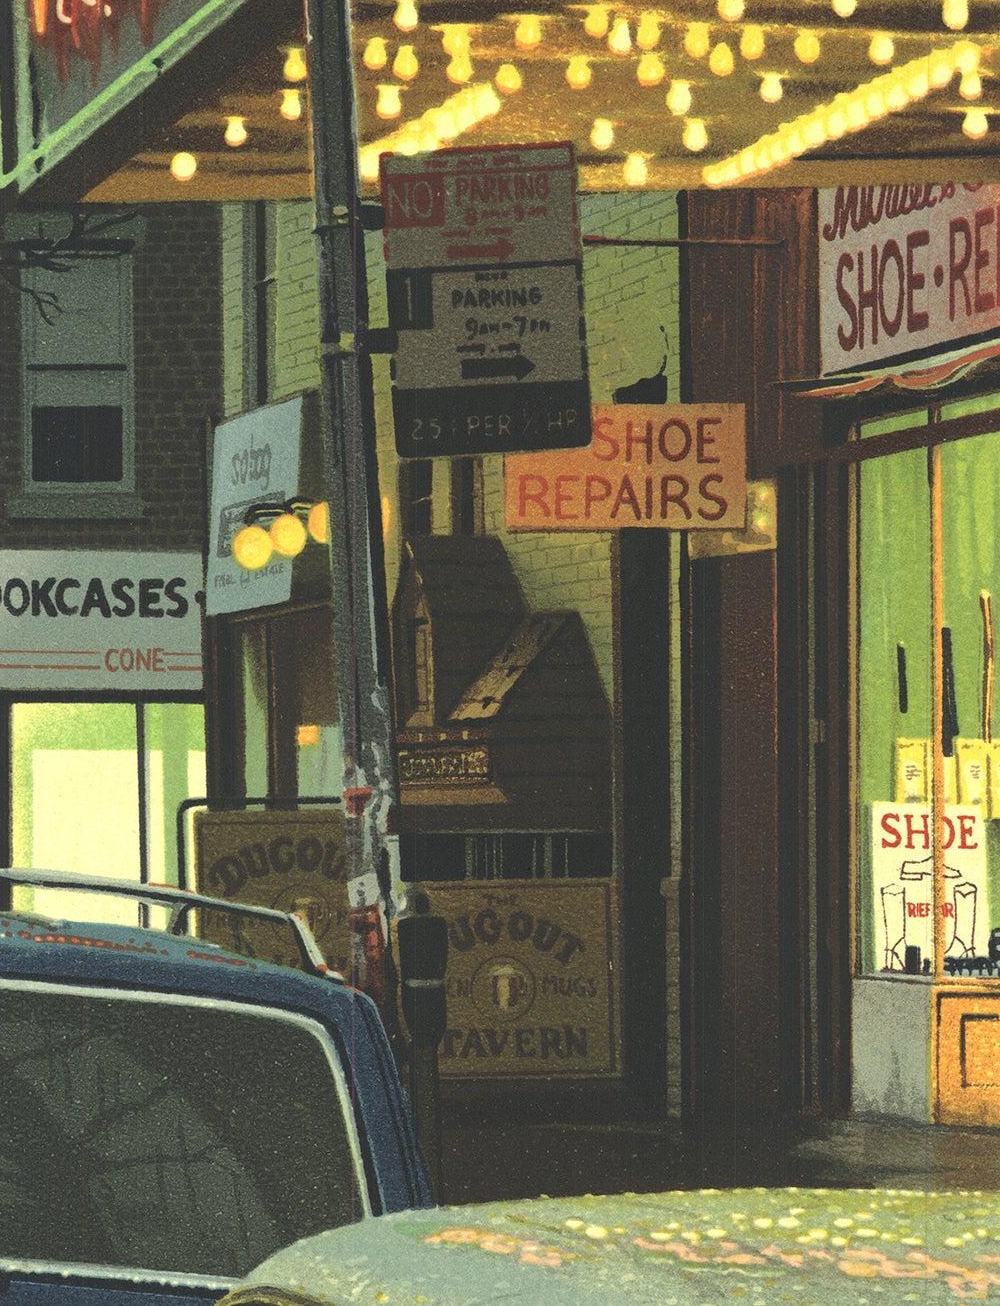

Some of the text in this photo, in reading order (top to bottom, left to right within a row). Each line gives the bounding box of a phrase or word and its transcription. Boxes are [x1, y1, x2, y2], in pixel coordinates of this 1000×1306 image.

[386, 181, 434, 220] NO
[451, 287, 544, 309] PARKING
[467, 415, 512, 437] PER
[592, 417, 722, 465] SHOE
[518, 474, 729, 522] REPAIRS
[105, 648, 166, 673] CONE
[440, 1027, 588, 1060] TAVERN
